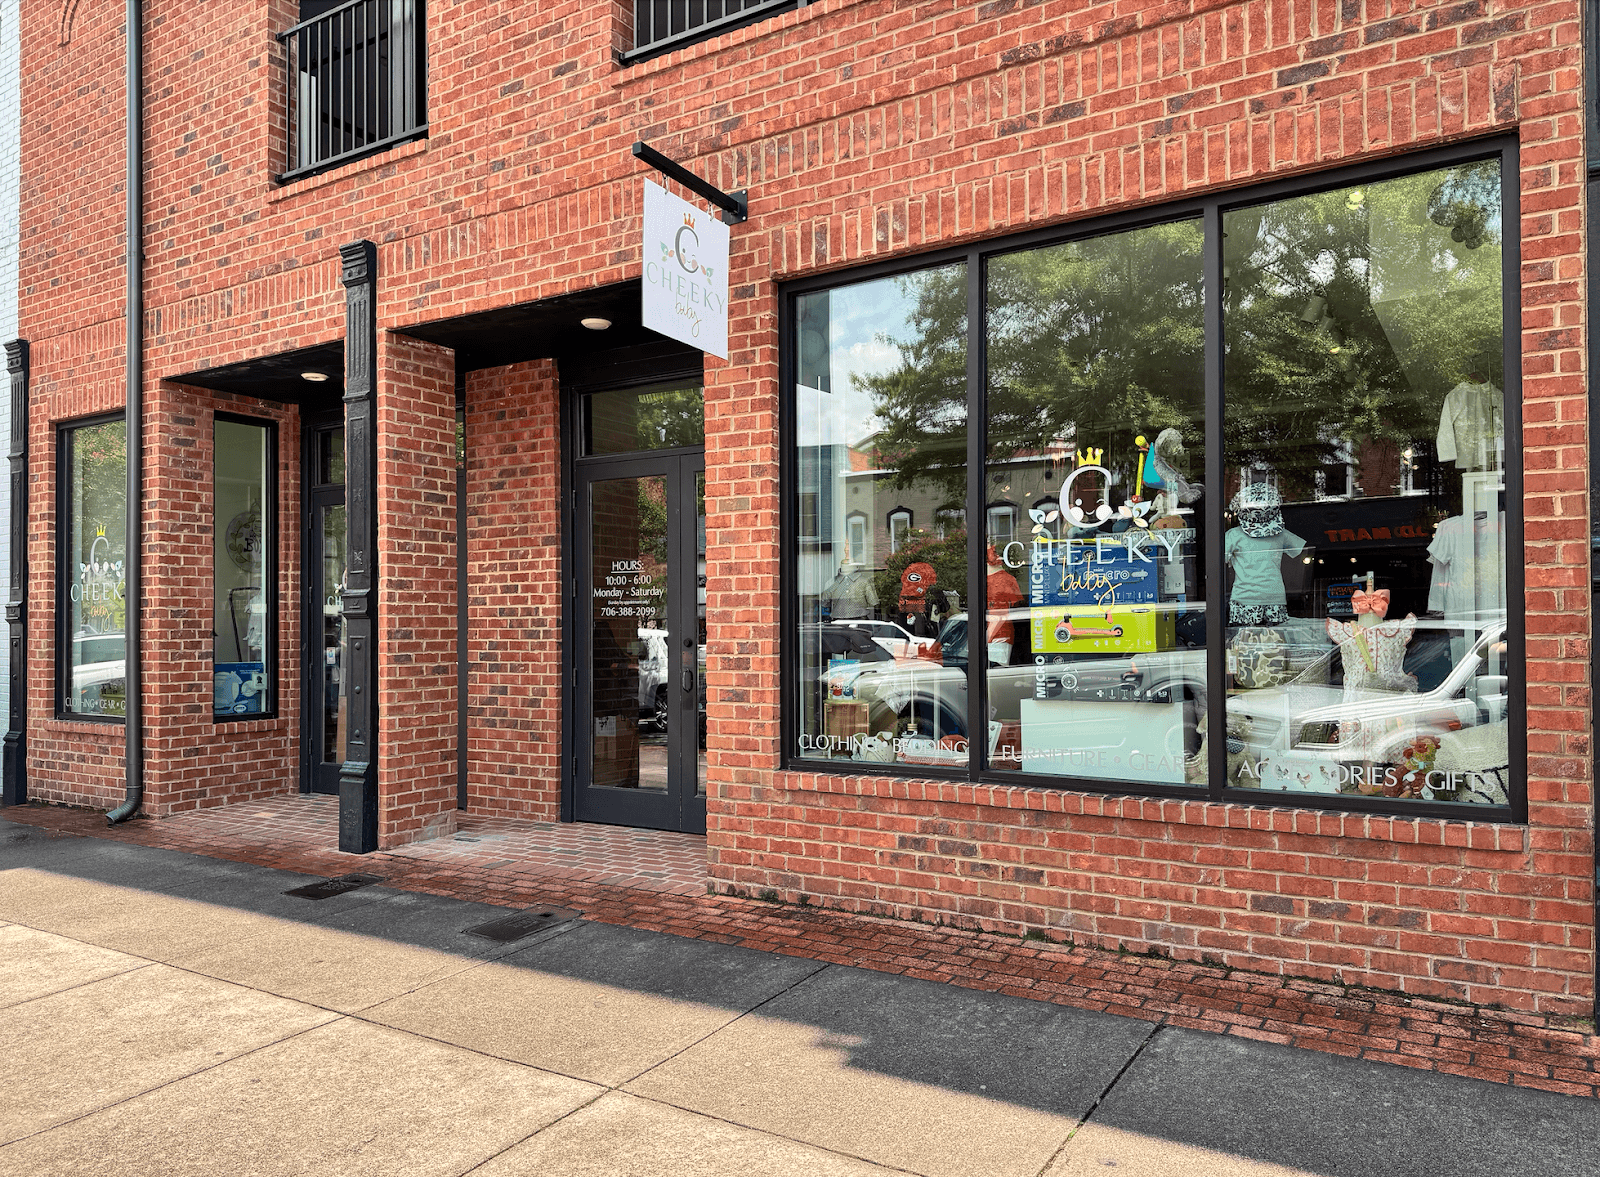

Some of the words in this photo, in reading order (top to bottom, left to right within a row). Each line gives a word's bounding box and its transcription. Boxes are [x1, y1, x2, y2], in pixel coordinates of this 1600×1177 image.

[646, 261, 726, 314] CHEEKY
[675, 287, 702, 338] baby
[1002, 533, 1183, 568] CHEEKY
[611, 560, 645, 571] HOURS:
[1031, 551, 1044, 604] MICRO
[593, 587, 624, 599] Monday
[630, 586, 664, 598] Saturday
[605, 576, 627, 586] 10:00
[633, 575, 652, 585] 6:00
[1060, 554, 1122, 613] baby
[600, 606, 656, 617] 706-388-2099
[1034, 610, 1044, 649] MICRO
[1035, 655, 1046, 698] MICRO
[65, 697, 95, 709] CLOTHING
[99, 699, 116, 710] GEAR
[892, 738, 968, 754] BEDDING
[1002, 745, 1107, 768] FURNITURE
[1129, 753, 1188, 774] GEAR
[1424, 770, 1497, 793] GIFTS
